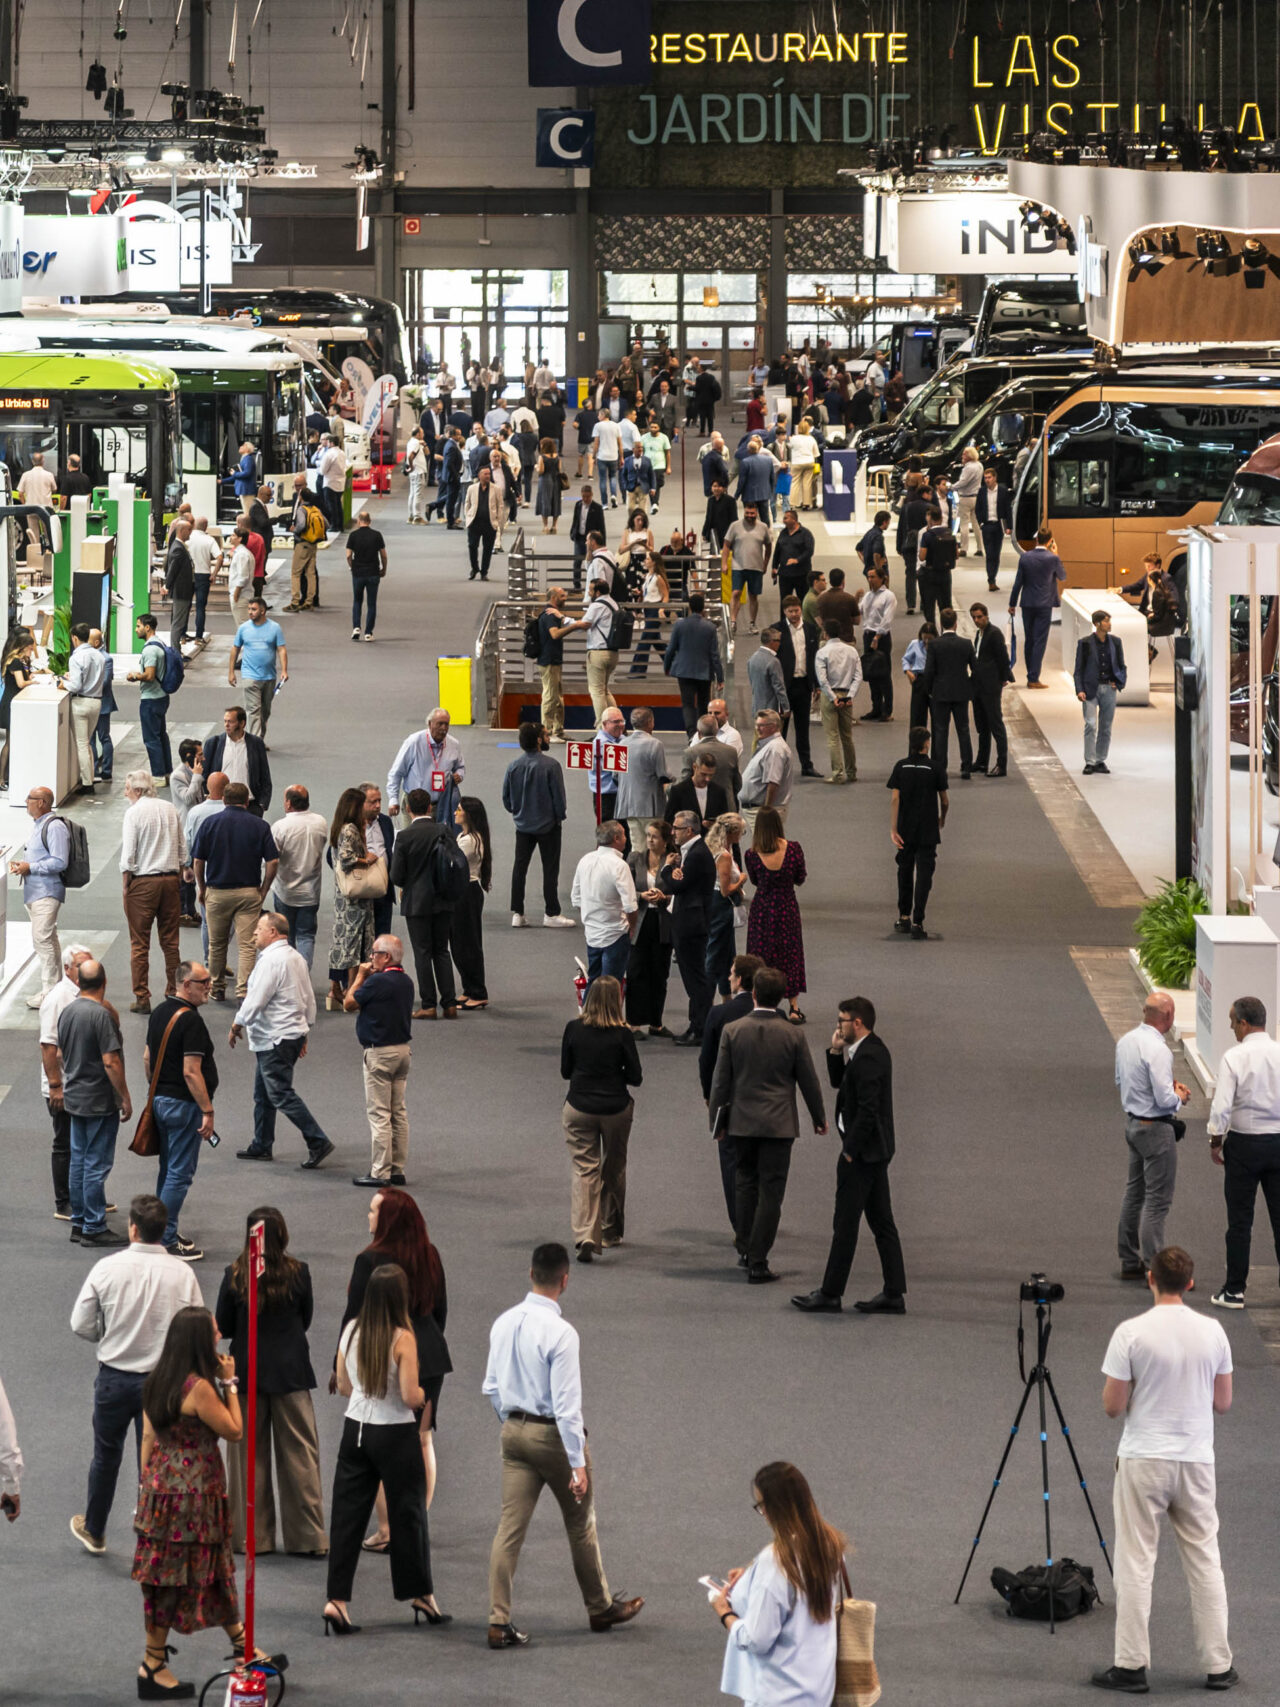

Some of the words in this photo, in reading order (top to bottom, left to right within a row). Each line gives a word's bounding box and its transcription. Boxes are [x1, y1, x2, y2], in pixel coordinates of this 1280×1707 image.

[557, 0, 622, 67] C
[974, 35, 1080, 88] LAS
[549, 117, 584, 160] C
[627, 77, 821, 145] JARDÍN
